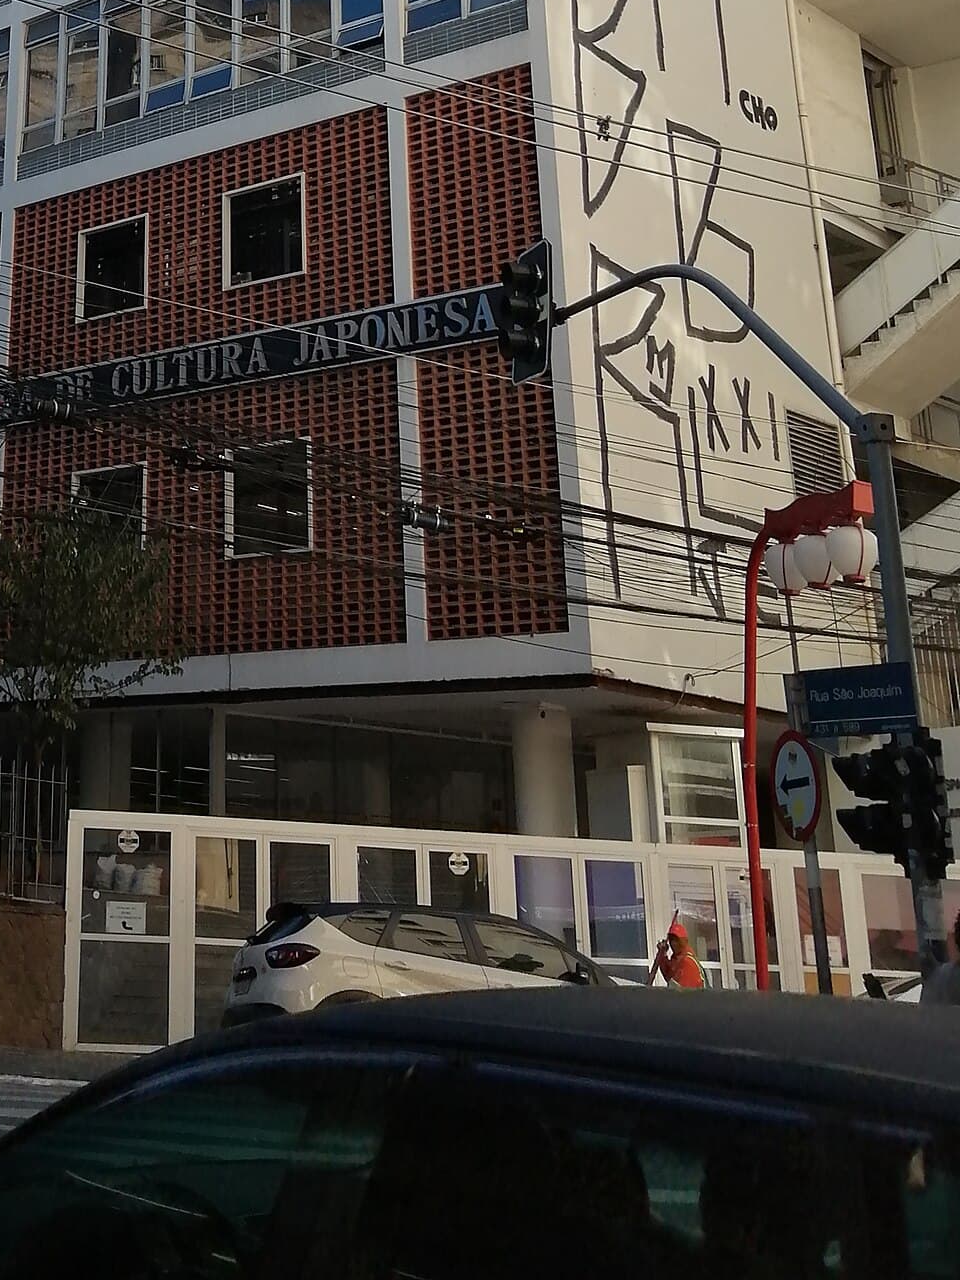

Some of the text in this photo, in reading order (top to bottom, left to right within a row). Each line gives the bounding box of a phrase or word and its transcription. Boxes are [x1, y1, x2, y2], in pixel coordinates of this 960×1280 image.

[738, 89, 778, 131] CHO
[112, 337, 270, 398] CULTURA
[292, 292, 500, 368] JAPONESA
[809, 689, 830, 703] Rua
[857, 684, 903, 702] Joaquim
